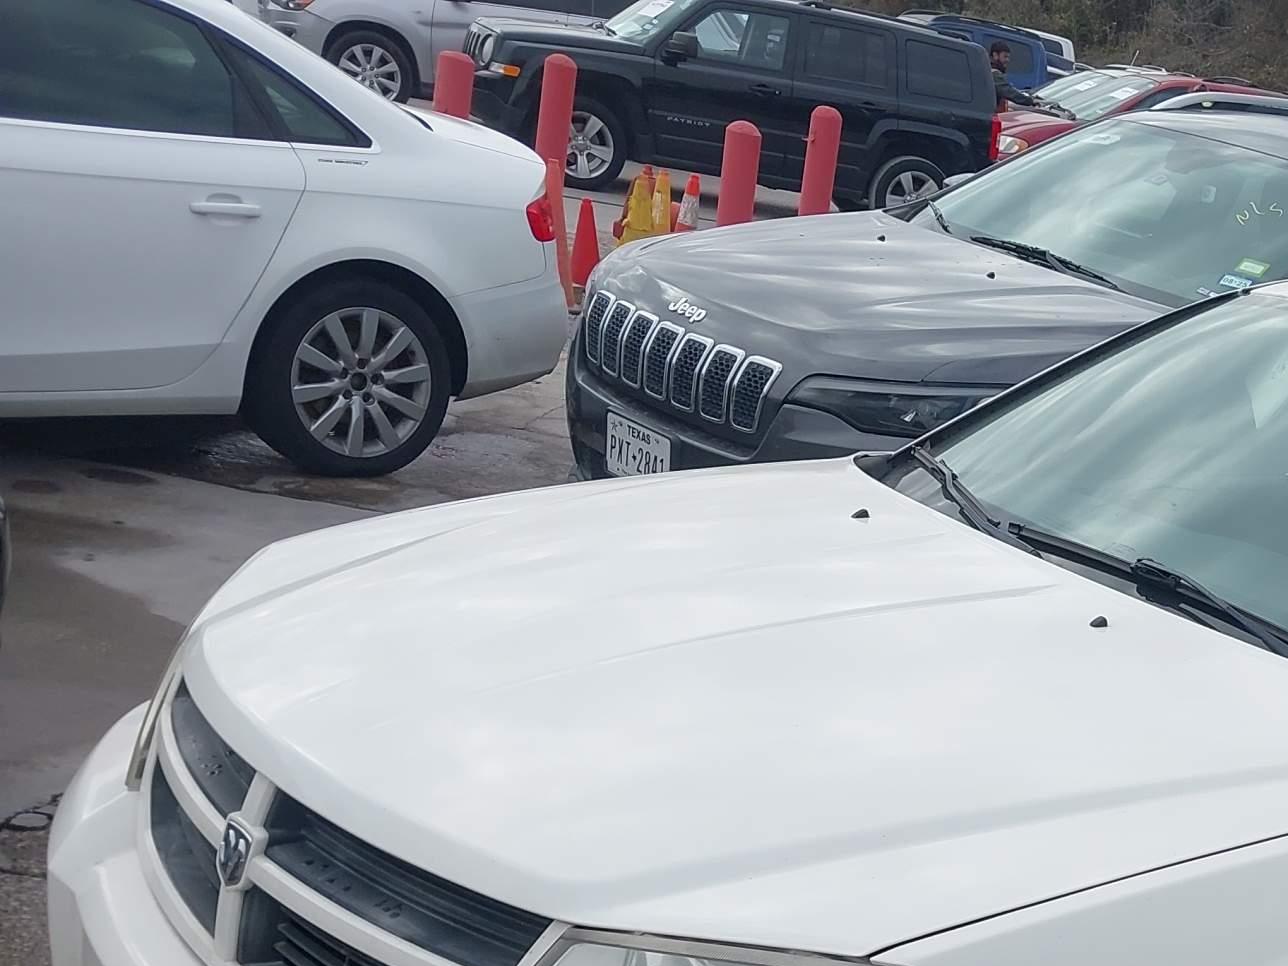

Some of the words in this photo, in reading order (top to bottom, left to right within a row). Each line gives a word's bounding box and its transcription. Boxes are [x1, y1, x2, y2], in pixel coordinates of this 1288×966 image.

[666, 115, 710, 127] PATRIOT
[668, 298, 707, 322] Jeep
[627, 423, 651, 445] TEXAS
